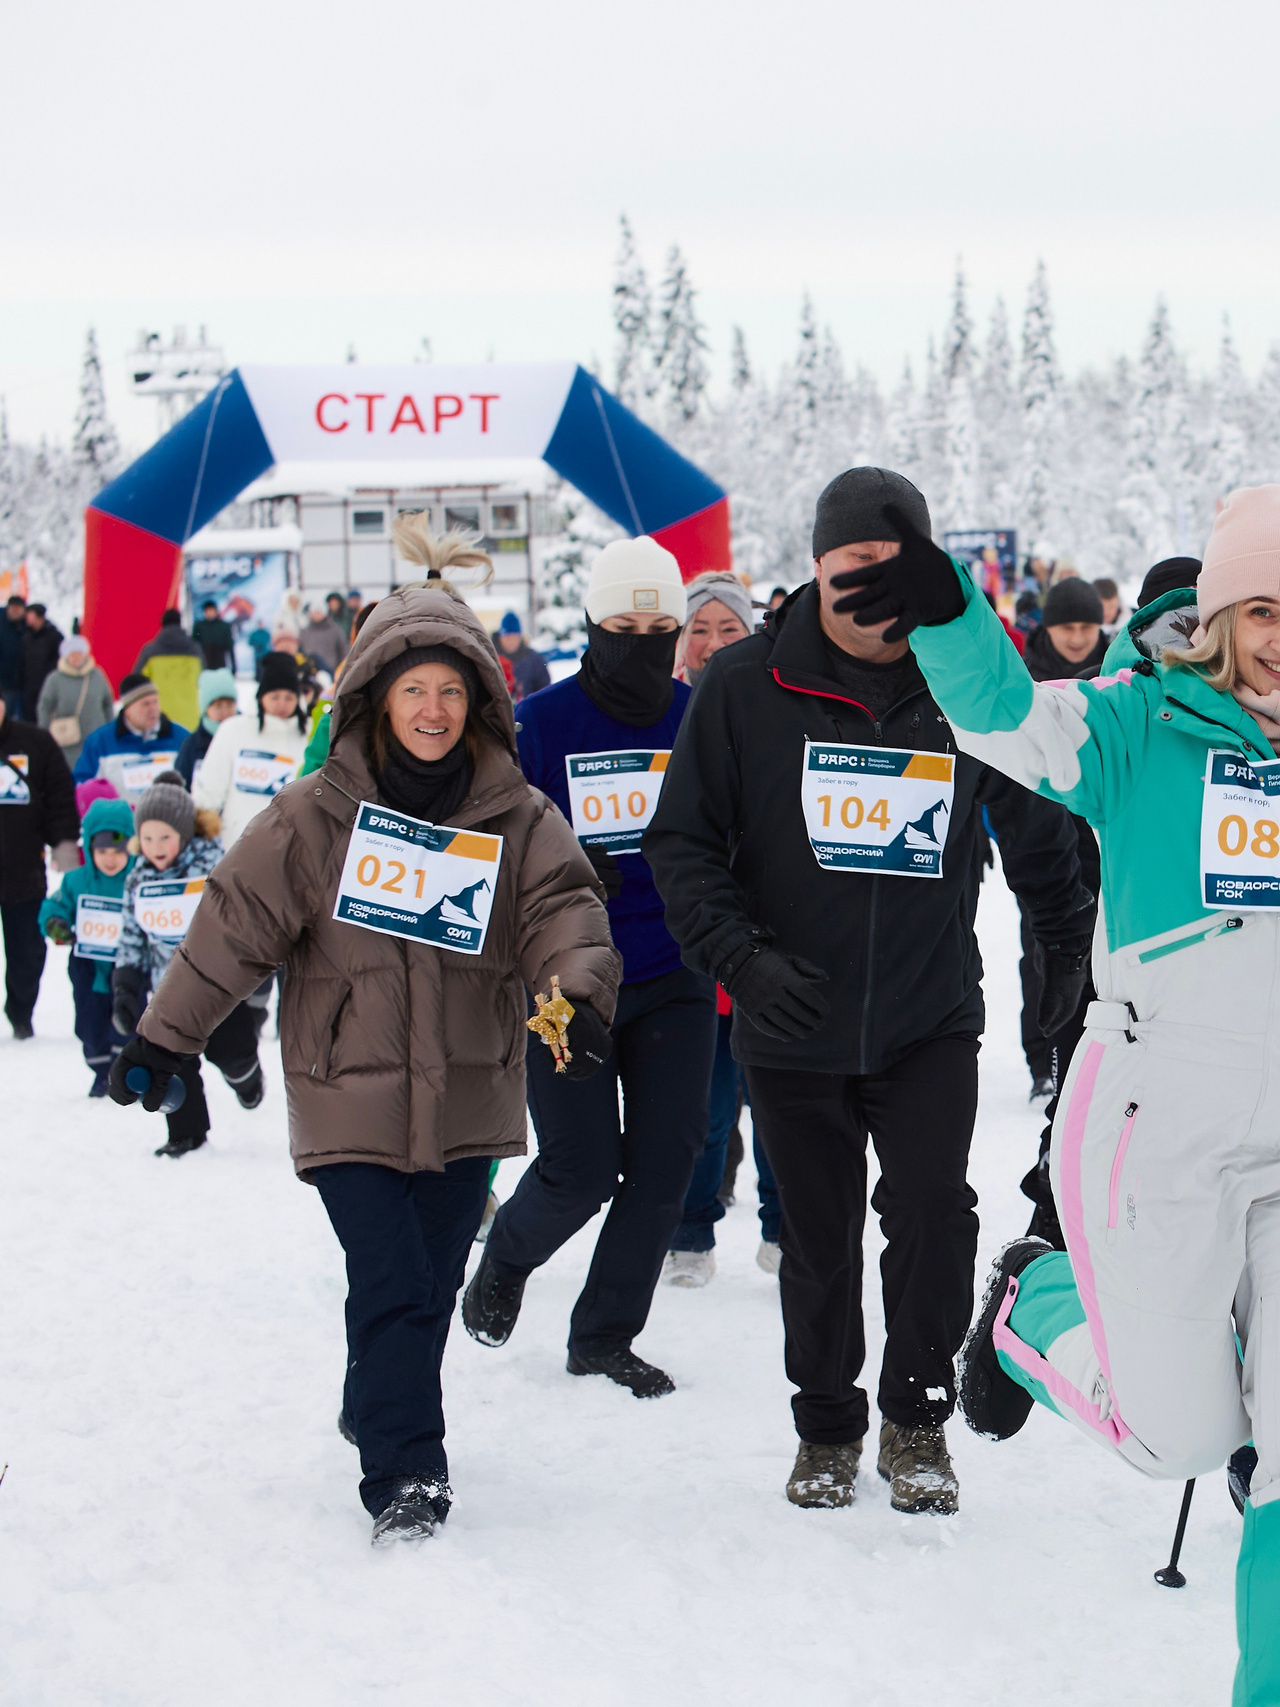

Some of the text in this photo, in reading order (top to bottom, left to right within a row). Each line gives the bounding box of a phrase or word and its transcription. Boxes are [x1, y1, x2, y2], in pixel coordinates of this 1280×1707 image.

[316, 394, 500, 433] СТАРТ
[578, 760, 612, 772] ВАРС
[818, 753, 858, 767] ВАРС
[582, 791, 646, 822] 010
[1223, 792, 1247, 802] Забег
[817, 795, 891, 831] 104
[368, 815, 408, 834] ВАРС
[365, 837, 384, 848] Забег
[356, 854, 426, 899] 021
[1216, 890, 1243, 898] ГОК
[142, 909, 183, 928] 068
[347, 908, 369, 920] ГОК
[348, 901, 418, 924] КОВДОРСКИЙ
[82, 920, 118, 940] 099
